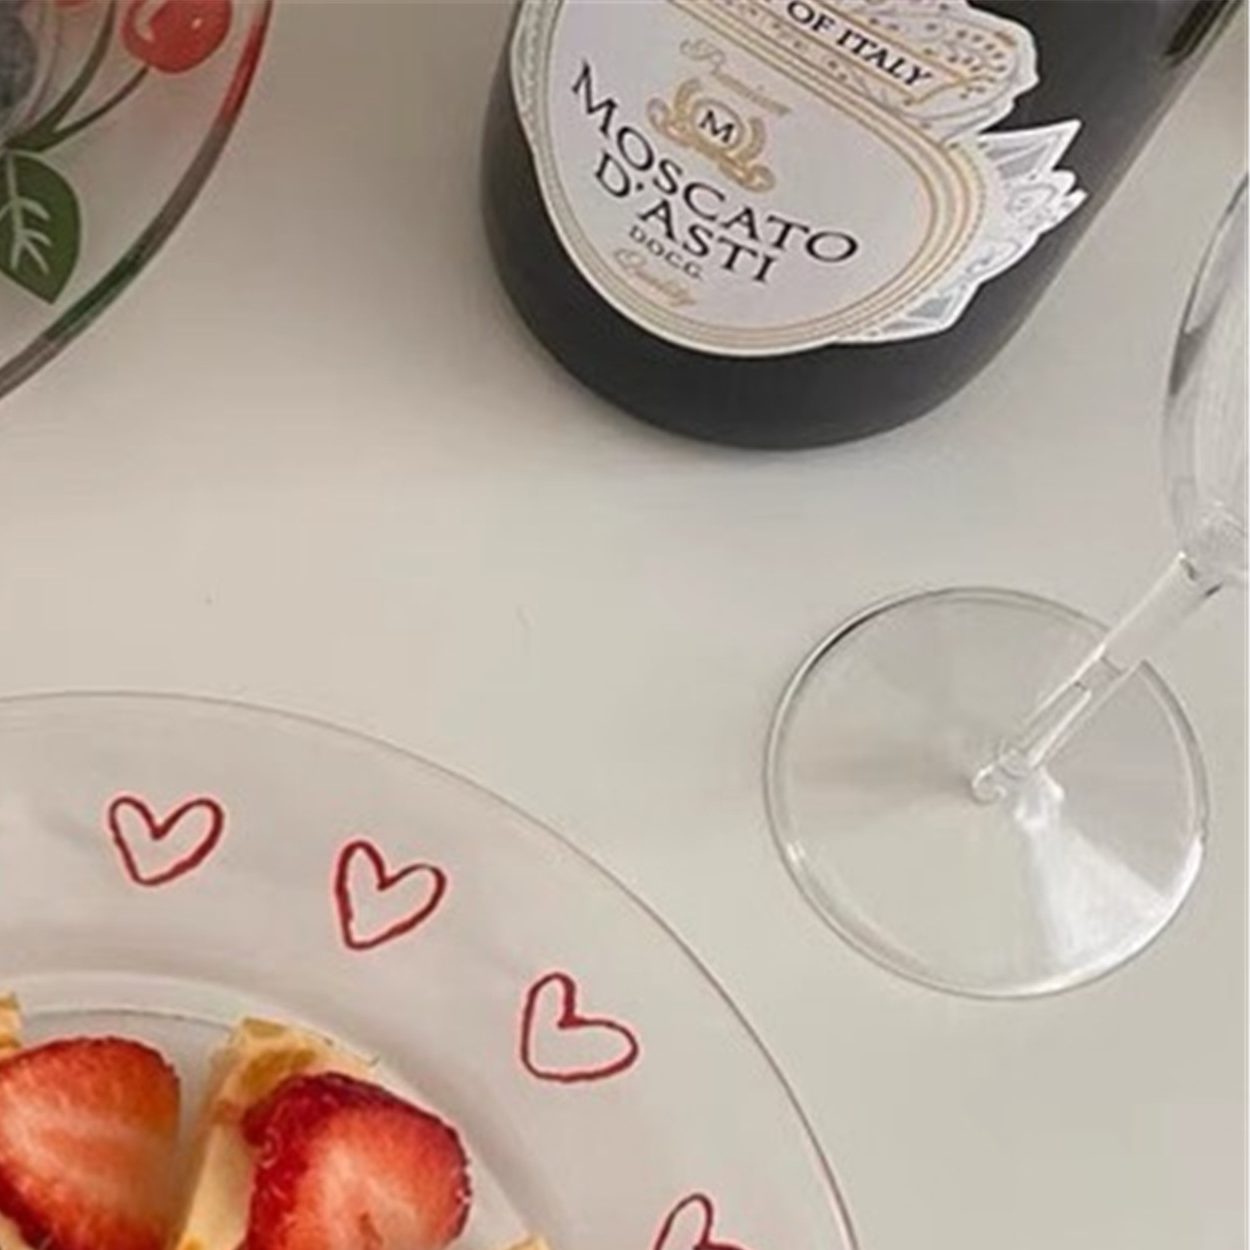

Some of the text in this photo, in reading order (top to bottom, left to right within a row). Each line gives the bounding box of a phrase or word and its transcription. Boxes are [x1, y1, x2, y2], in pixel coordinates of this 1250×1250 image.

[787, 0, 836, 32] OF
[836, 28, 933, 86] ITALY
[571, 58, 858, 263] MOSCATO
[698, 109, 735, 143] M
[595, 151, 776, 283] D'ASTI
